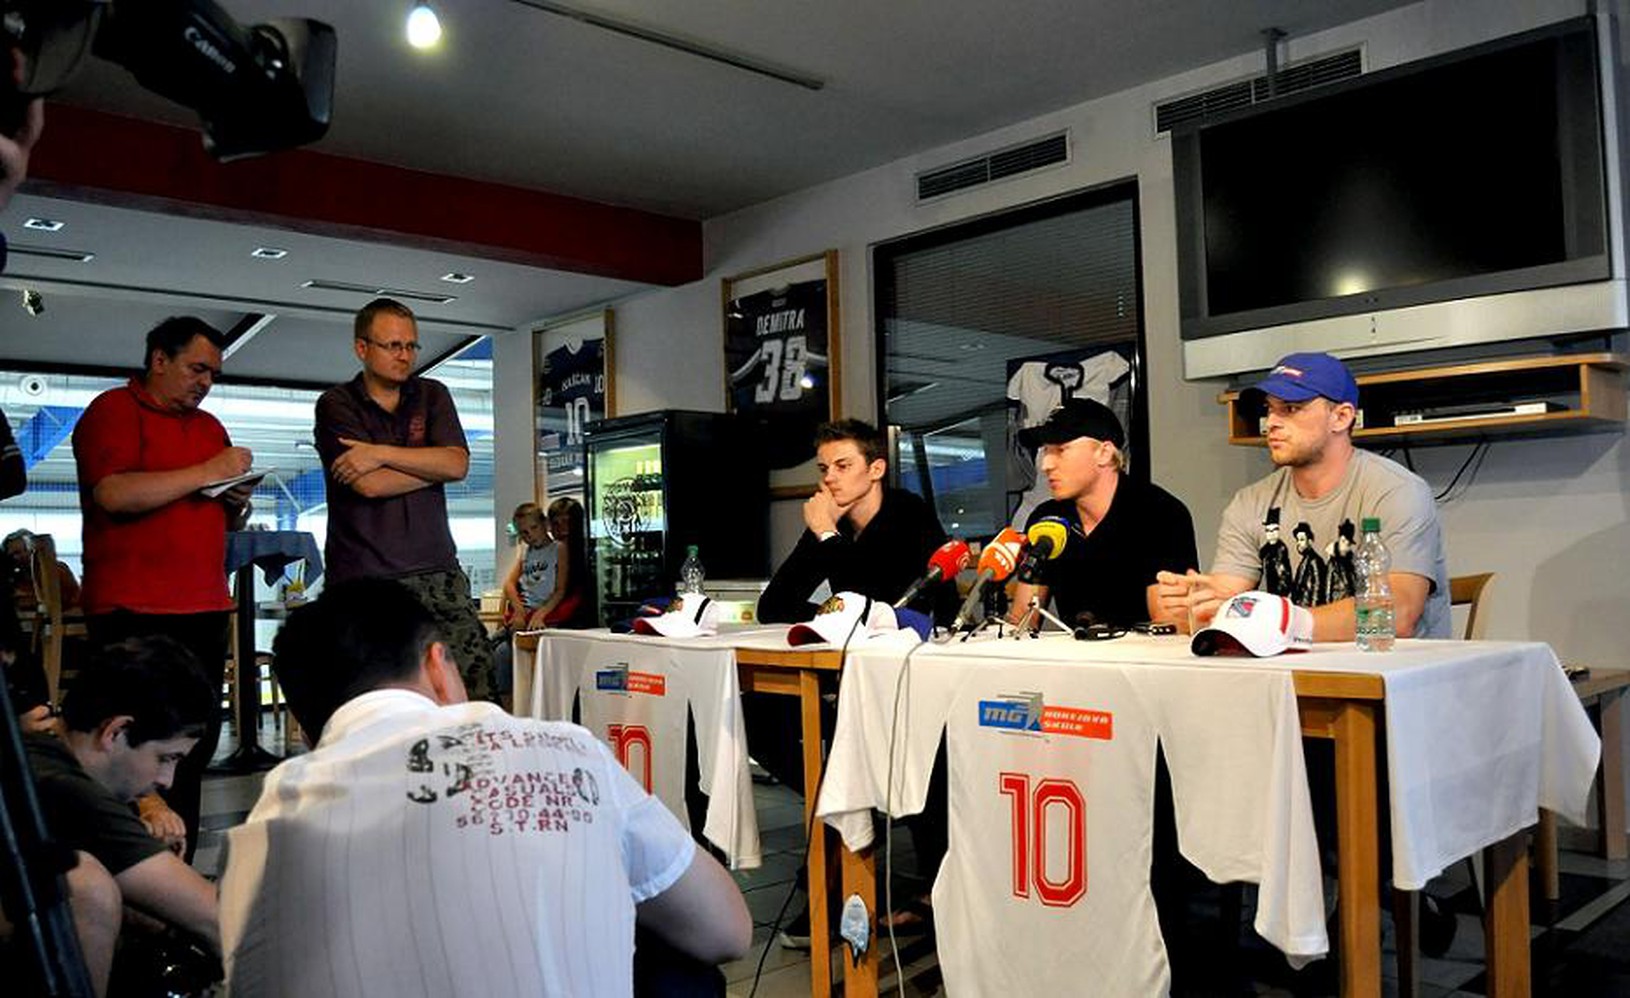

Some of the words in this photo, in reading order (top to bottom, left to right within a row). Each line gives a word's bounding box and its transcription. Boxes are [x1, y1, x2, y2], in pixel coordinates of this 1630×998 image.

[184, 26, 236, 74] Canon
[755, 307, 806, 337] DEMITRA
[754, 334, 808, 404] 38
[564, 396, 590, 446] 10
[999, 772, 1087, 907] 10
